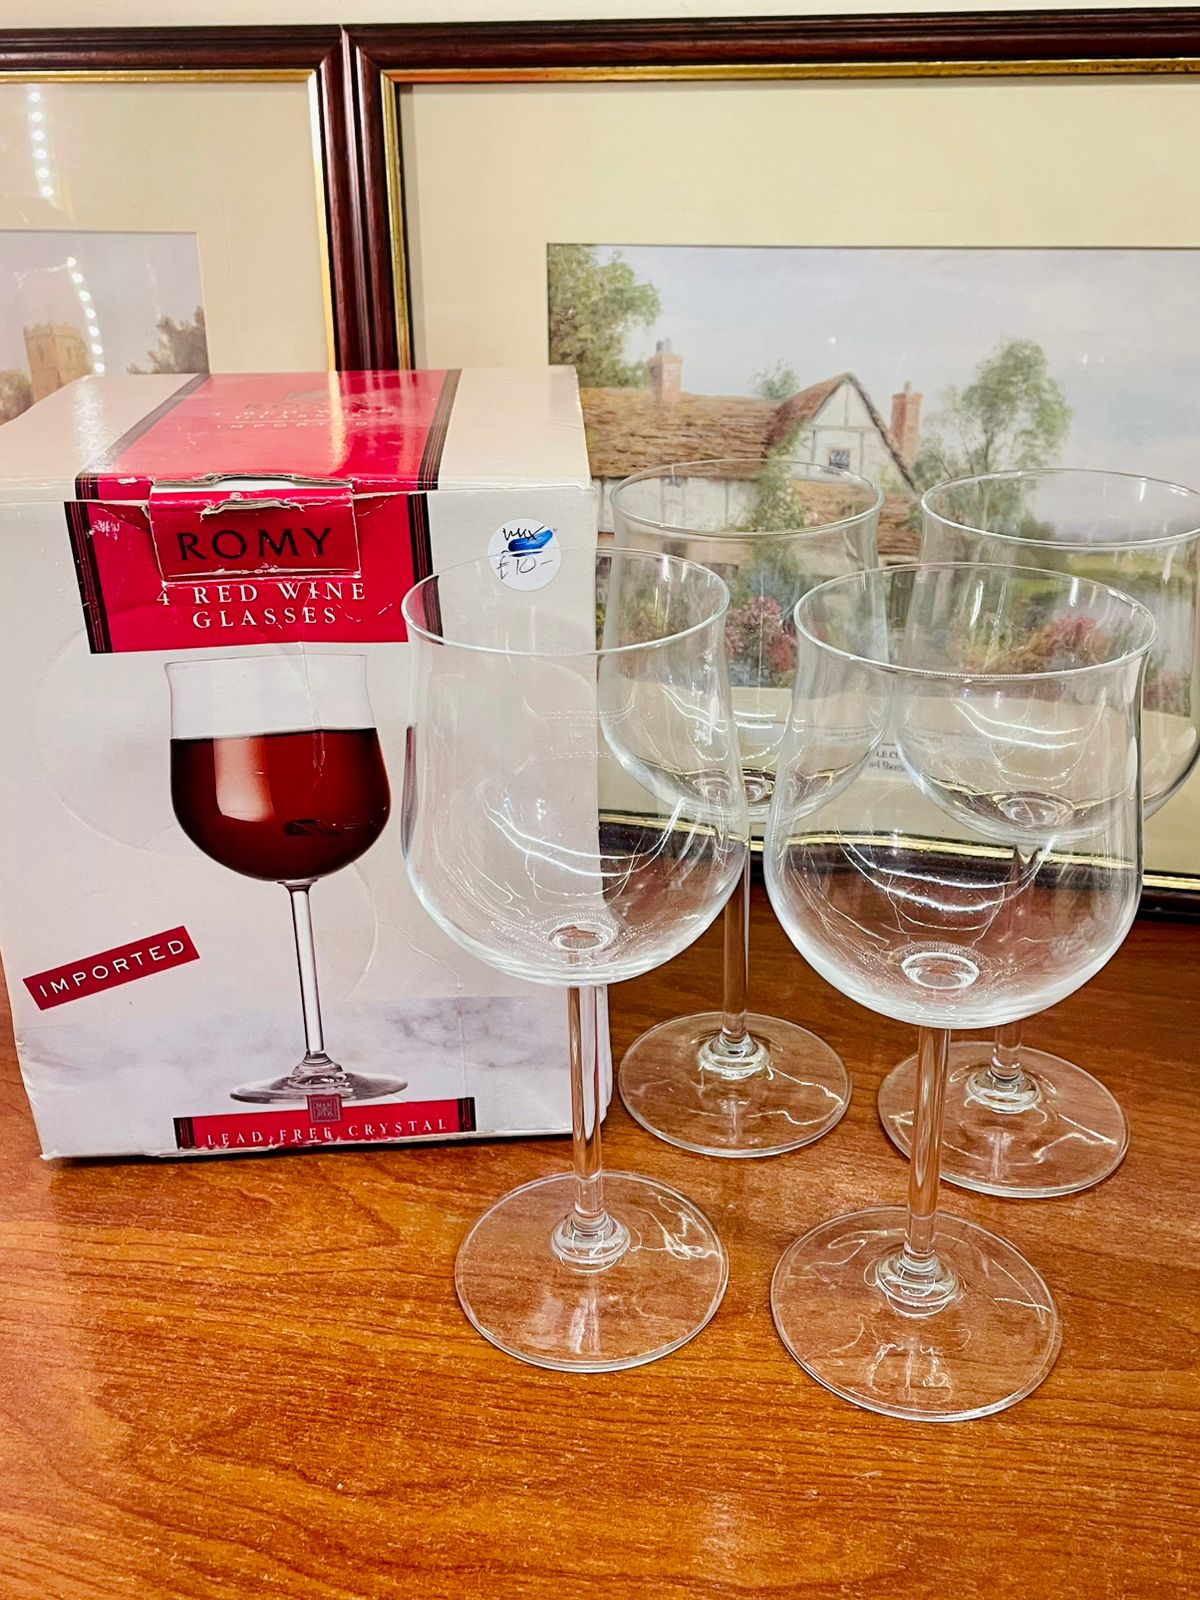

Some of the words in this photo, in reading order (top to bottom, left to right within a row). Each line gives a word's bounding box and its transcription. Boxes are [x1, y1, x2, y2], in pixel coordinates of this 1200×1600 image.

[176, 527, 332, 561] ROMY
[156, 589, 170, 606] 4
[192, 584, 258, 605] RED
[277, 582, 366, 600] WINE
[192, 606, 337, 629] GLASSES
[39, 939, 185, 998] IMPORTED
[207, 1131, 263, 1146] LEAD
[279, 1127, 333, 1142] FREE
[348, 1118, 447, 1137] CRYSTAL
